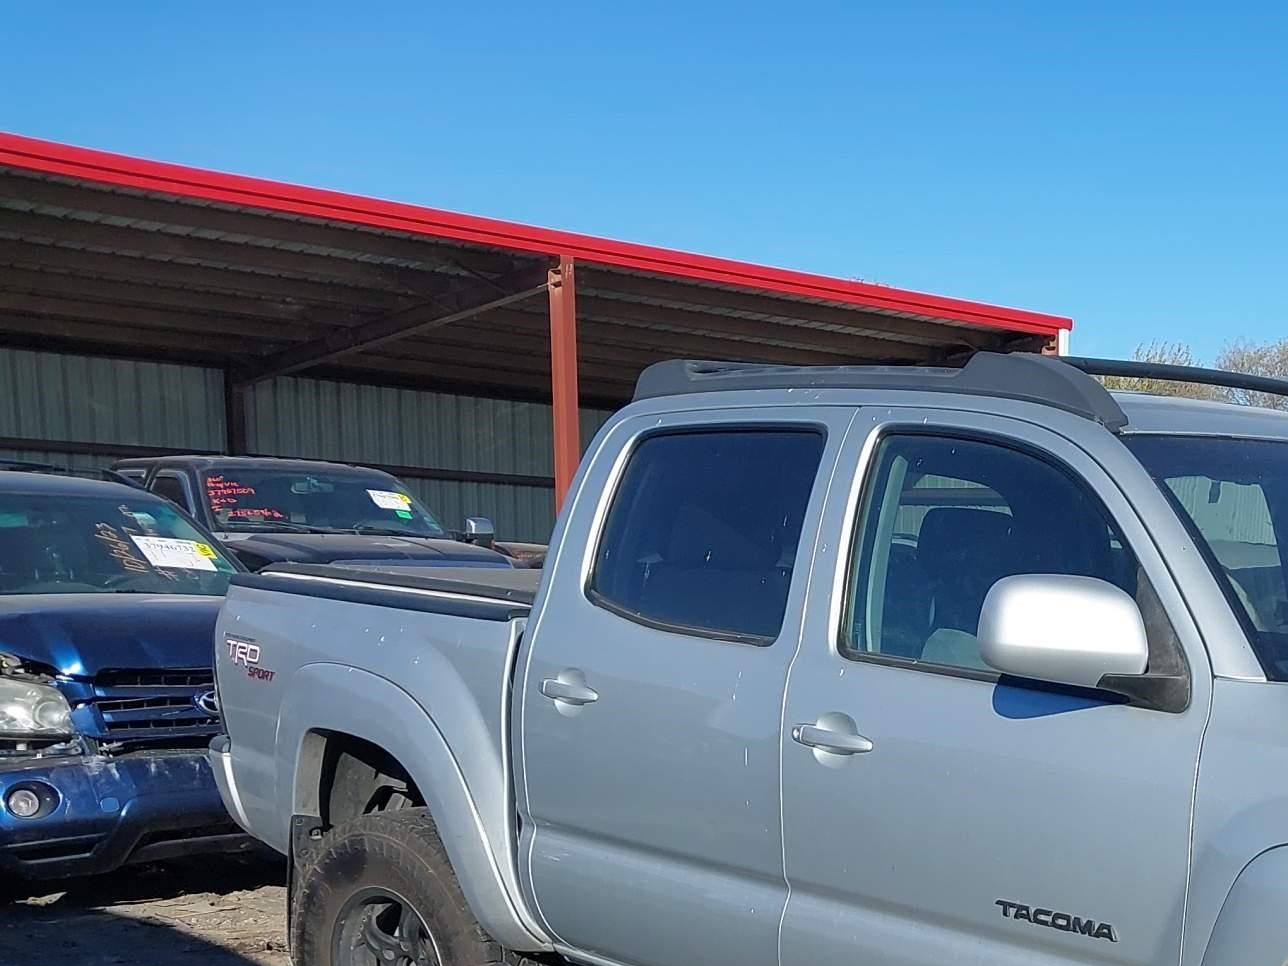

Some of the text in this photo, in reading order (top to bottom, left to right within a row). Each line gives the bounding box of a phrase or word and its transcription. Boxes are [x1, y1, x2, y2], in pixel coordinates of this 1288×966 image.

[226, 639, 261, 665] TRD
[247, 666, 276, 682] SPORT
[994, 899, 1120, 943] TACOMA
